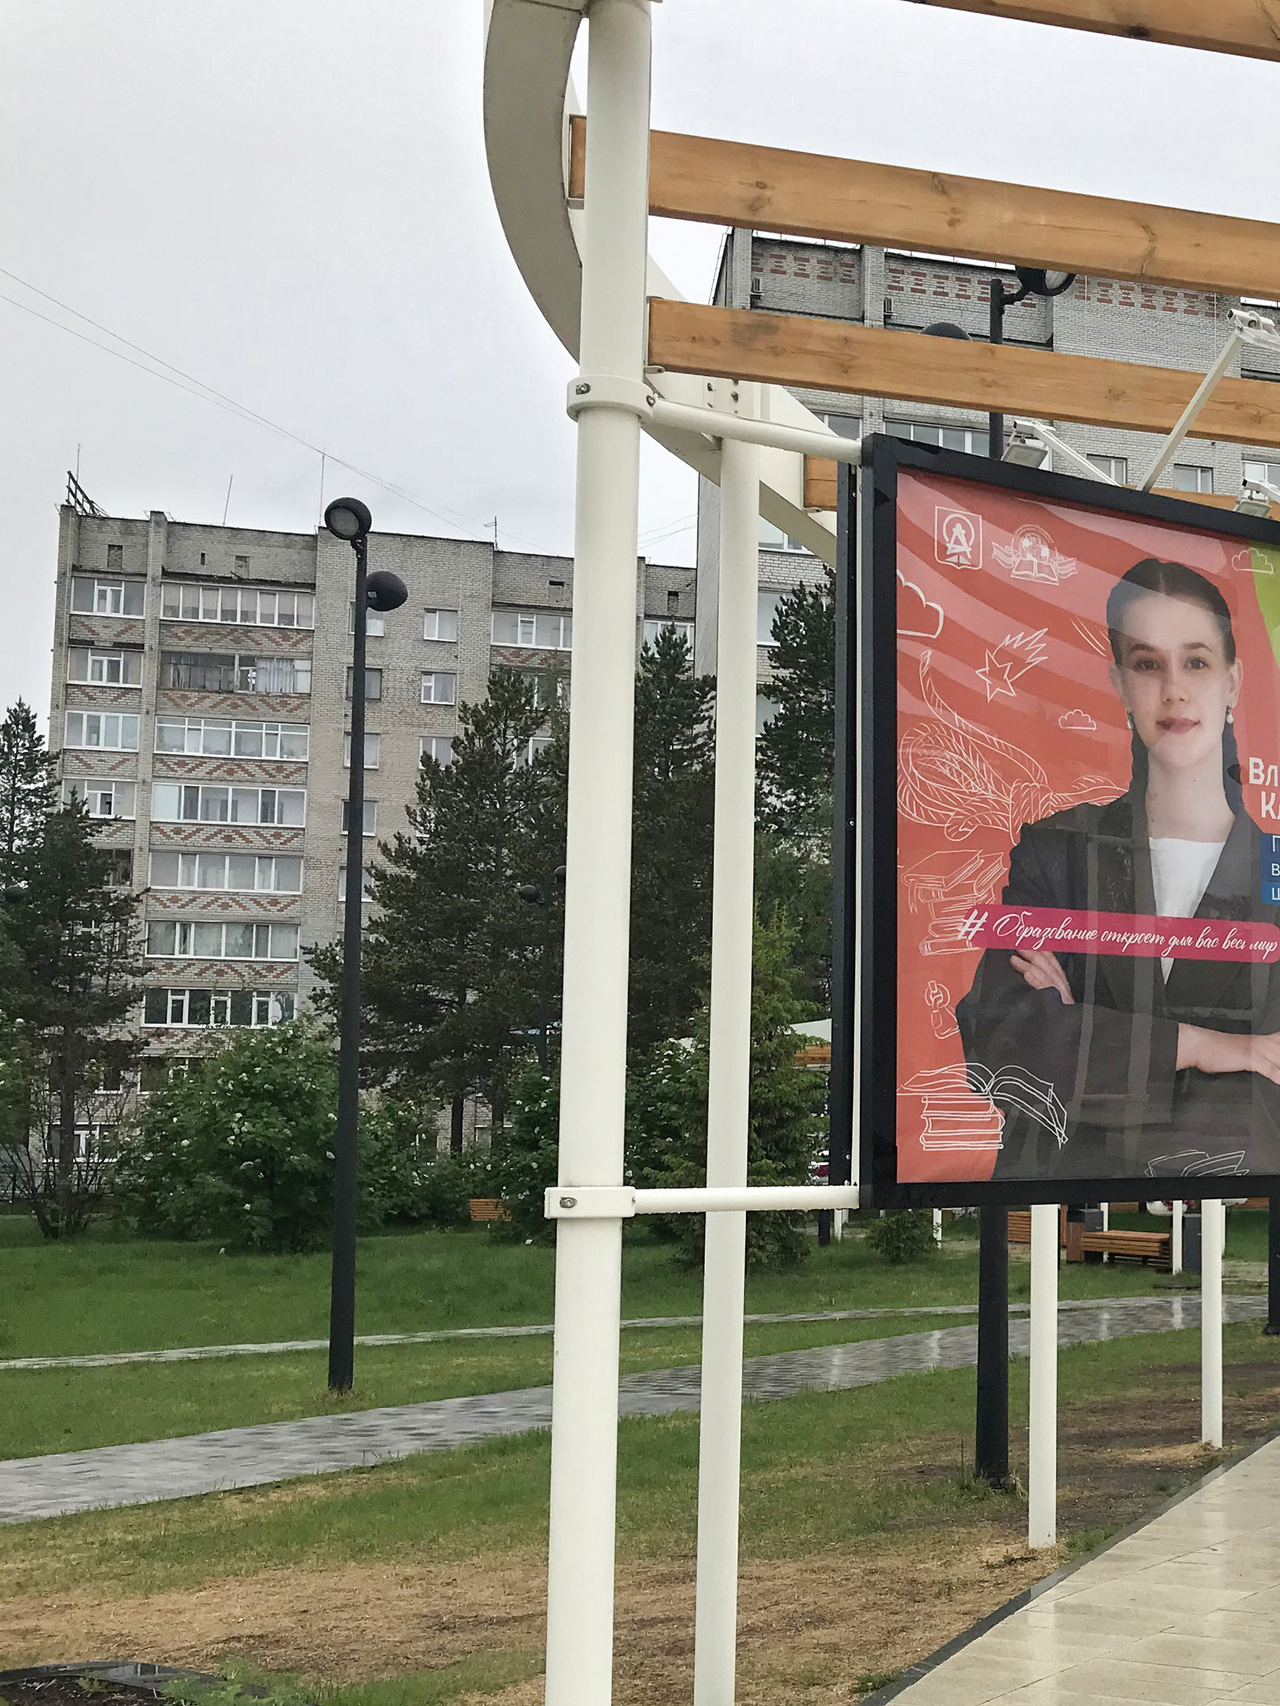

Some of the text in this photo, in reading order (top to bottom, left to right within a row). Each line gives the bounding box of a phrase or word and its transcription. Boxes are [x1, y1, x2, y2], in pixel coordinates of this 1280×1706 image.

[1161, 935, 1193, 958] для
[1195, 926, 1219, 949] вас
[1248, 940, 1278, 960] мир
